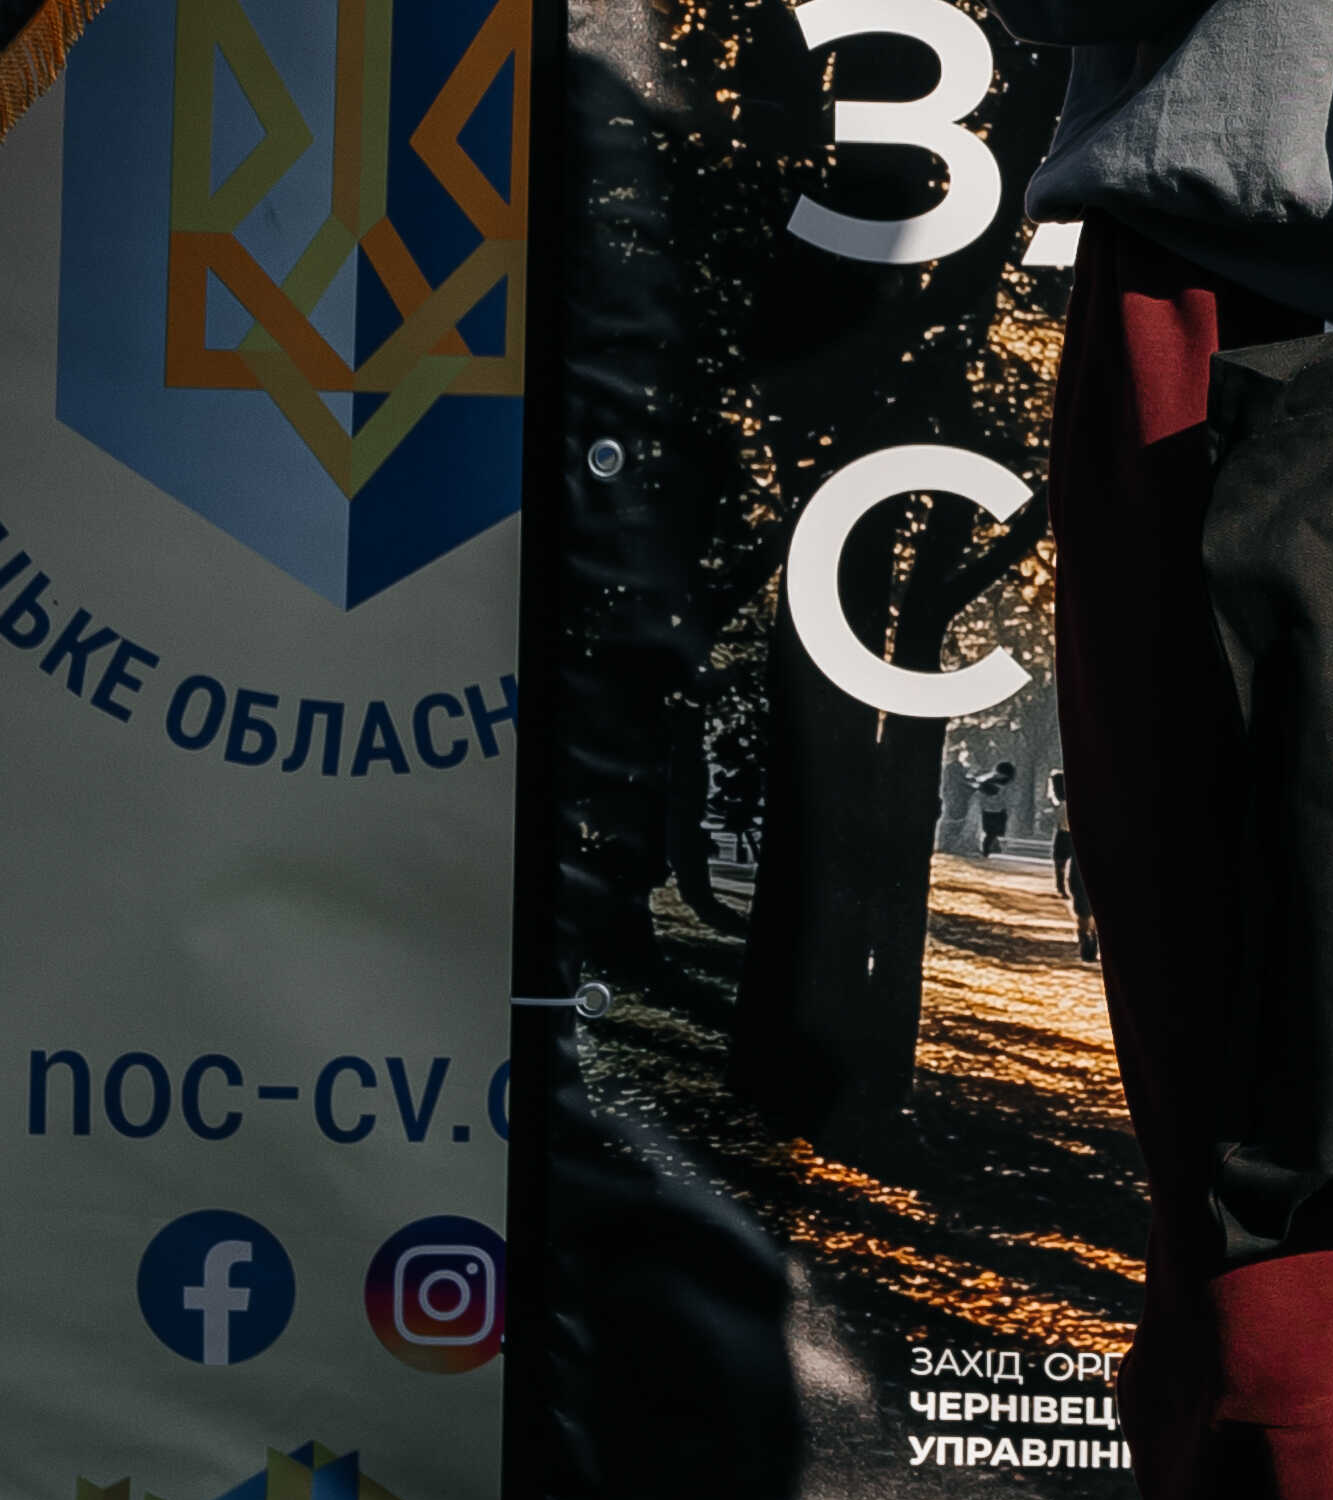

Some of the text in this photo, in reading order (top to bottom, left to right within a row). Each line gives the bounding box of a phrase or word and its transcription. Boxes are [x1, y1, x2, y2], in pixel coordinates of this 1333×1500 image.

[0, 522, 160, 722] ЬКЕ
[910, 1346, 1024, 1385] ЗАХІД
[908, 1391, 1120, 1431] ЧЕРНІВЕЦ
